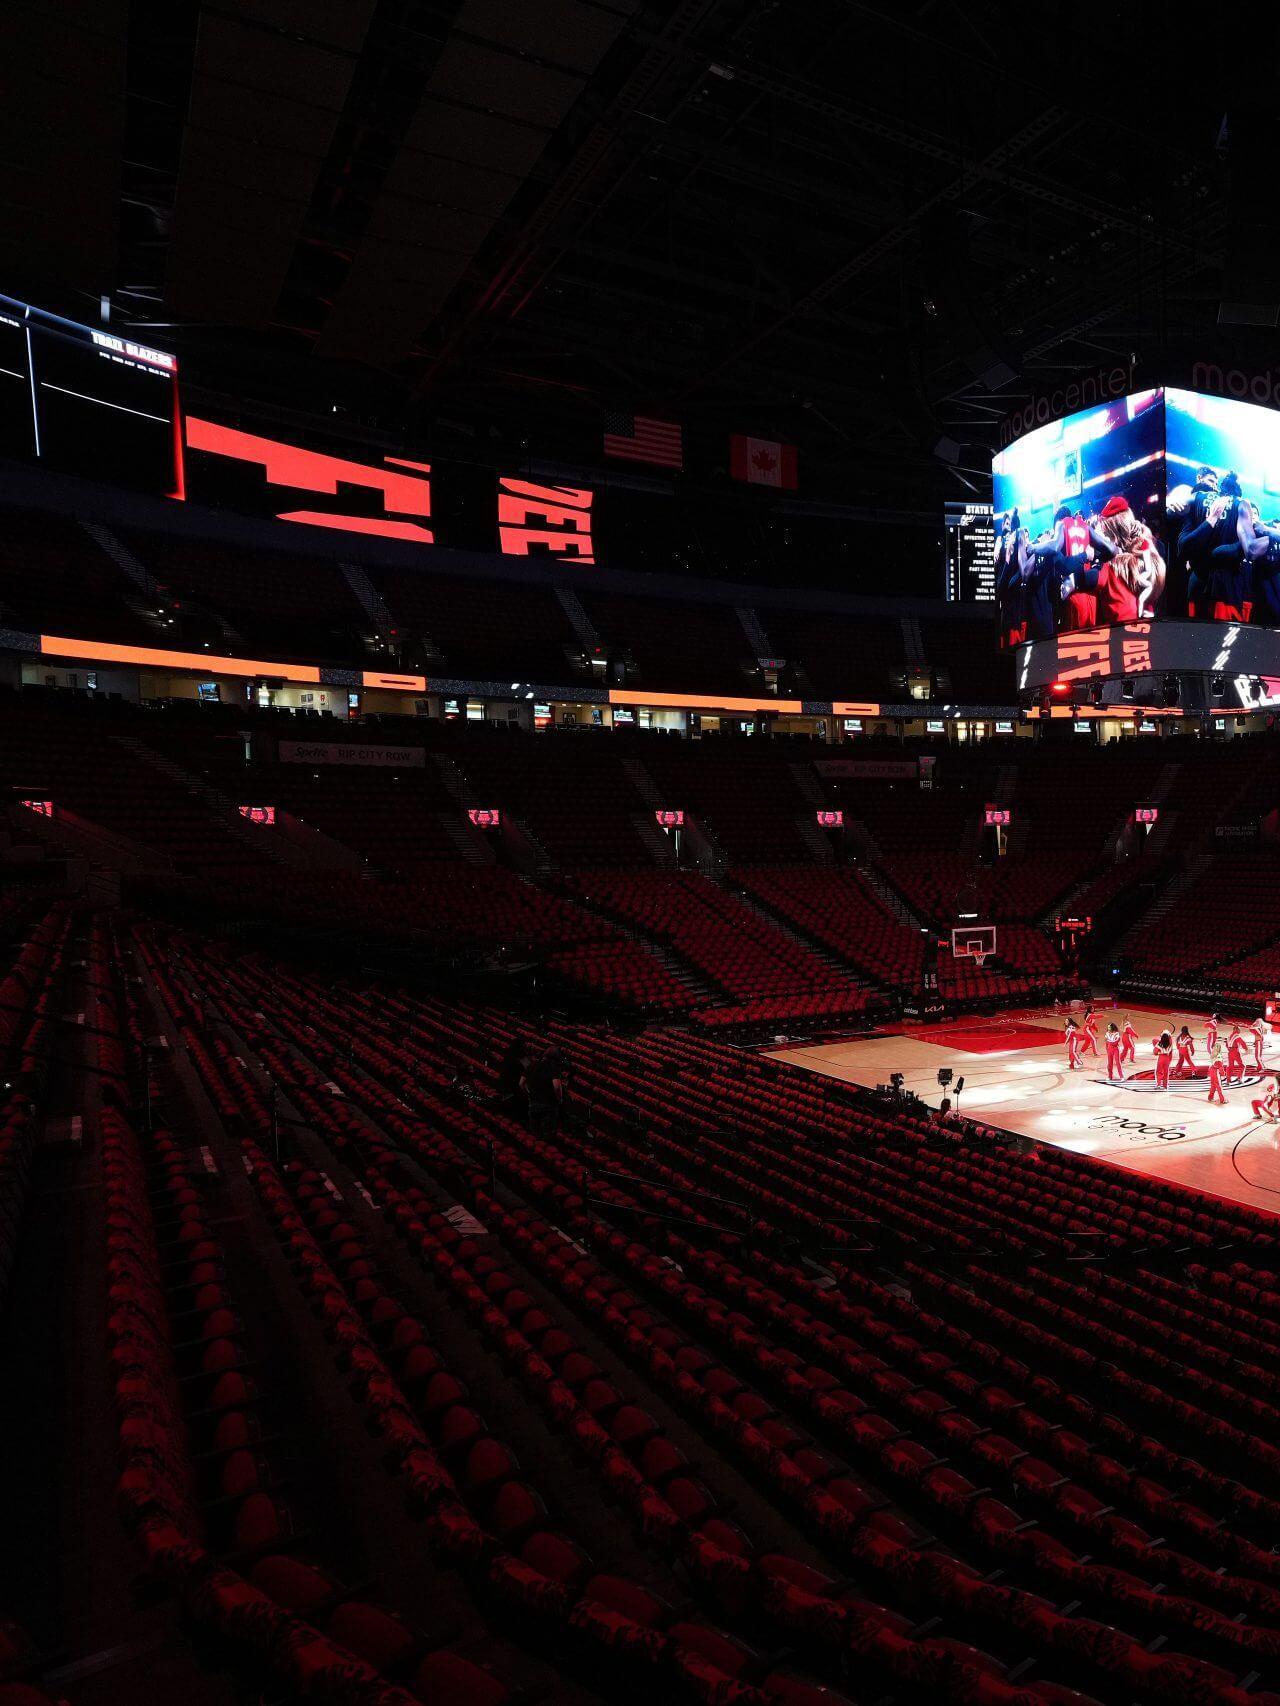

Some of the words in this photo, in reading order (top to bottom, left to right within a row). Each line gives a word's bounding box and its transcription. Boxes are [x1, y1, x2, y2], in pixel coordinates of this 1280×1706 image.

[296, 747, 328, 758] Sprite
[358, 750, 384, 760] CITY
[385, 751, 410, 761] ROW
